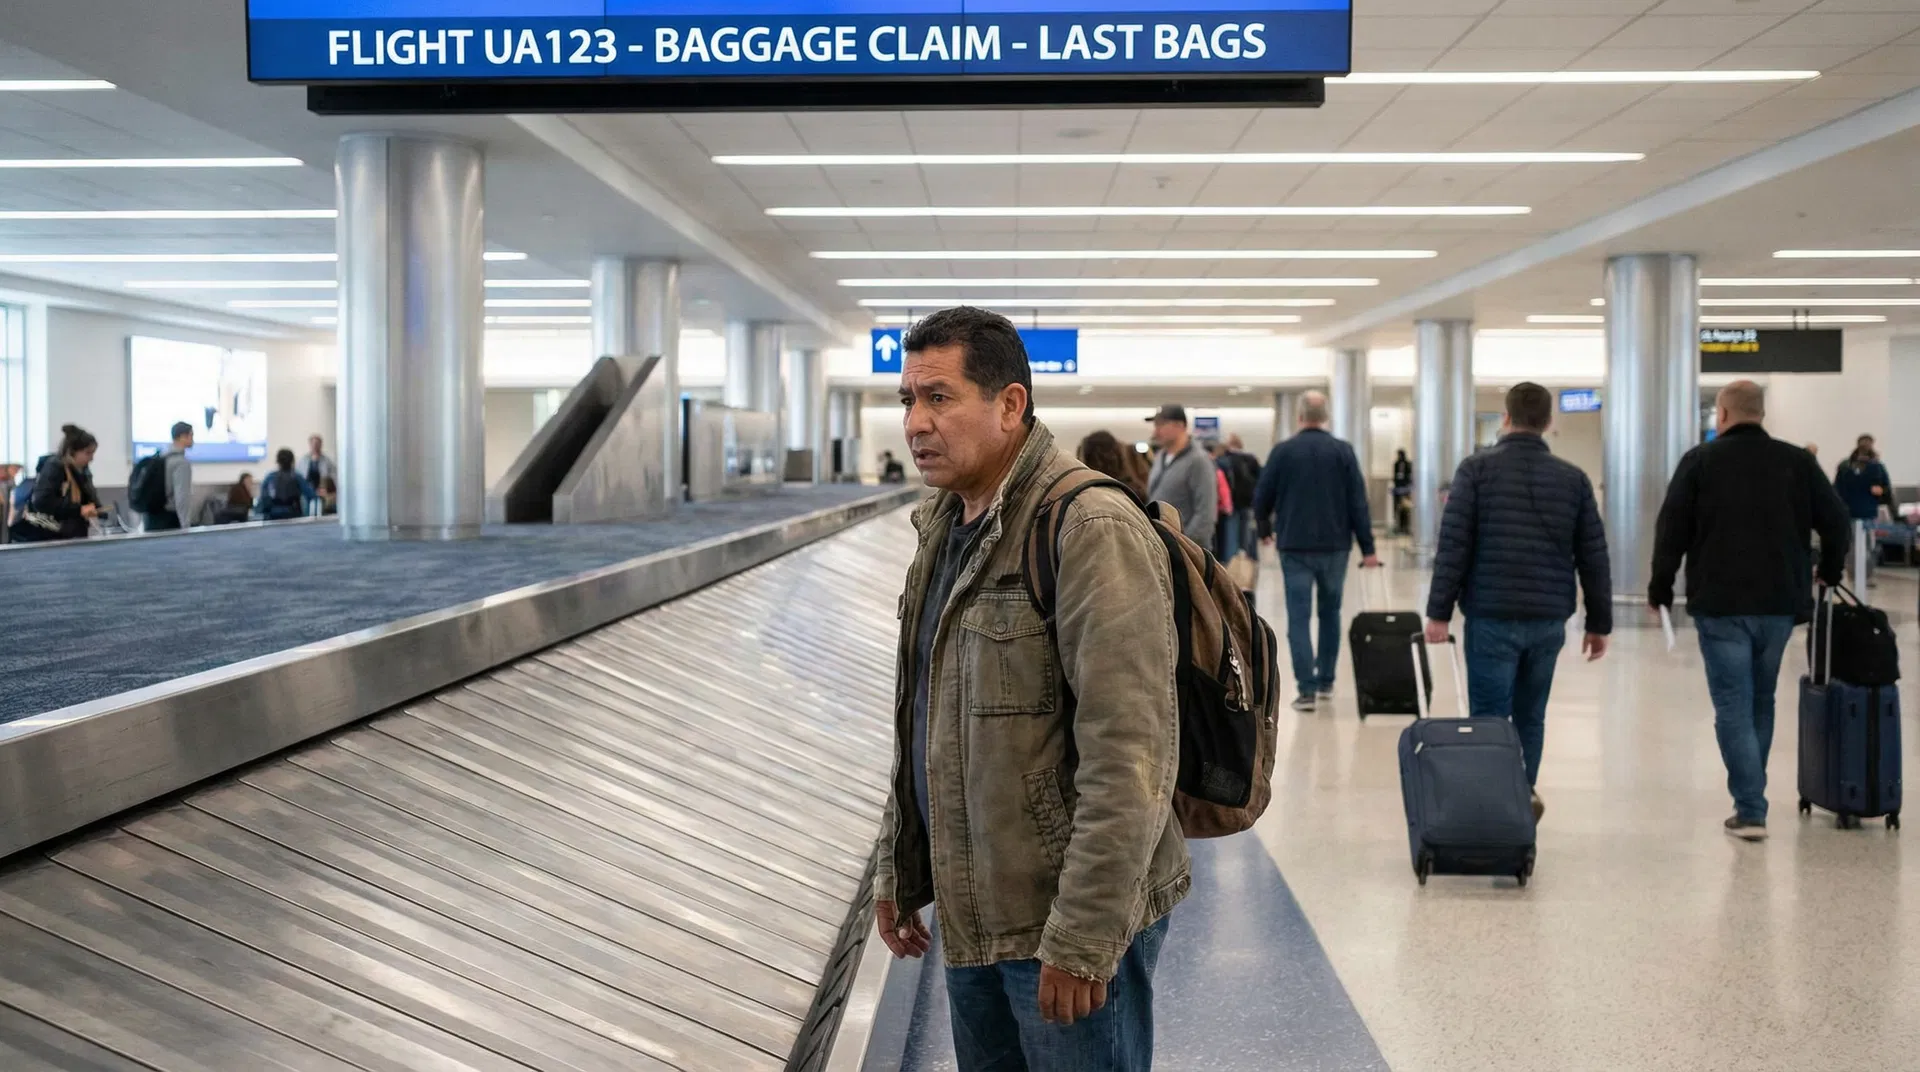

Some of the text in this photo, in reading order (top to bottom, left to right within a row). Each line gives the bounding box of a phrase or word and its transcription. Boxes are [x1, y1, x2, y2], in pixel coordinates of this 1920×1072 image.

[328, 29, 474, 65] FLIGHT
[484, 28, 617, 65] UA123
[655, 26, 857, 63] BAGGAGE
[868, 25, 1001, 62] CLAIM
[1039, 23, 1144, 60] LAST
[1154, 22, 1267, 60] BAGS
